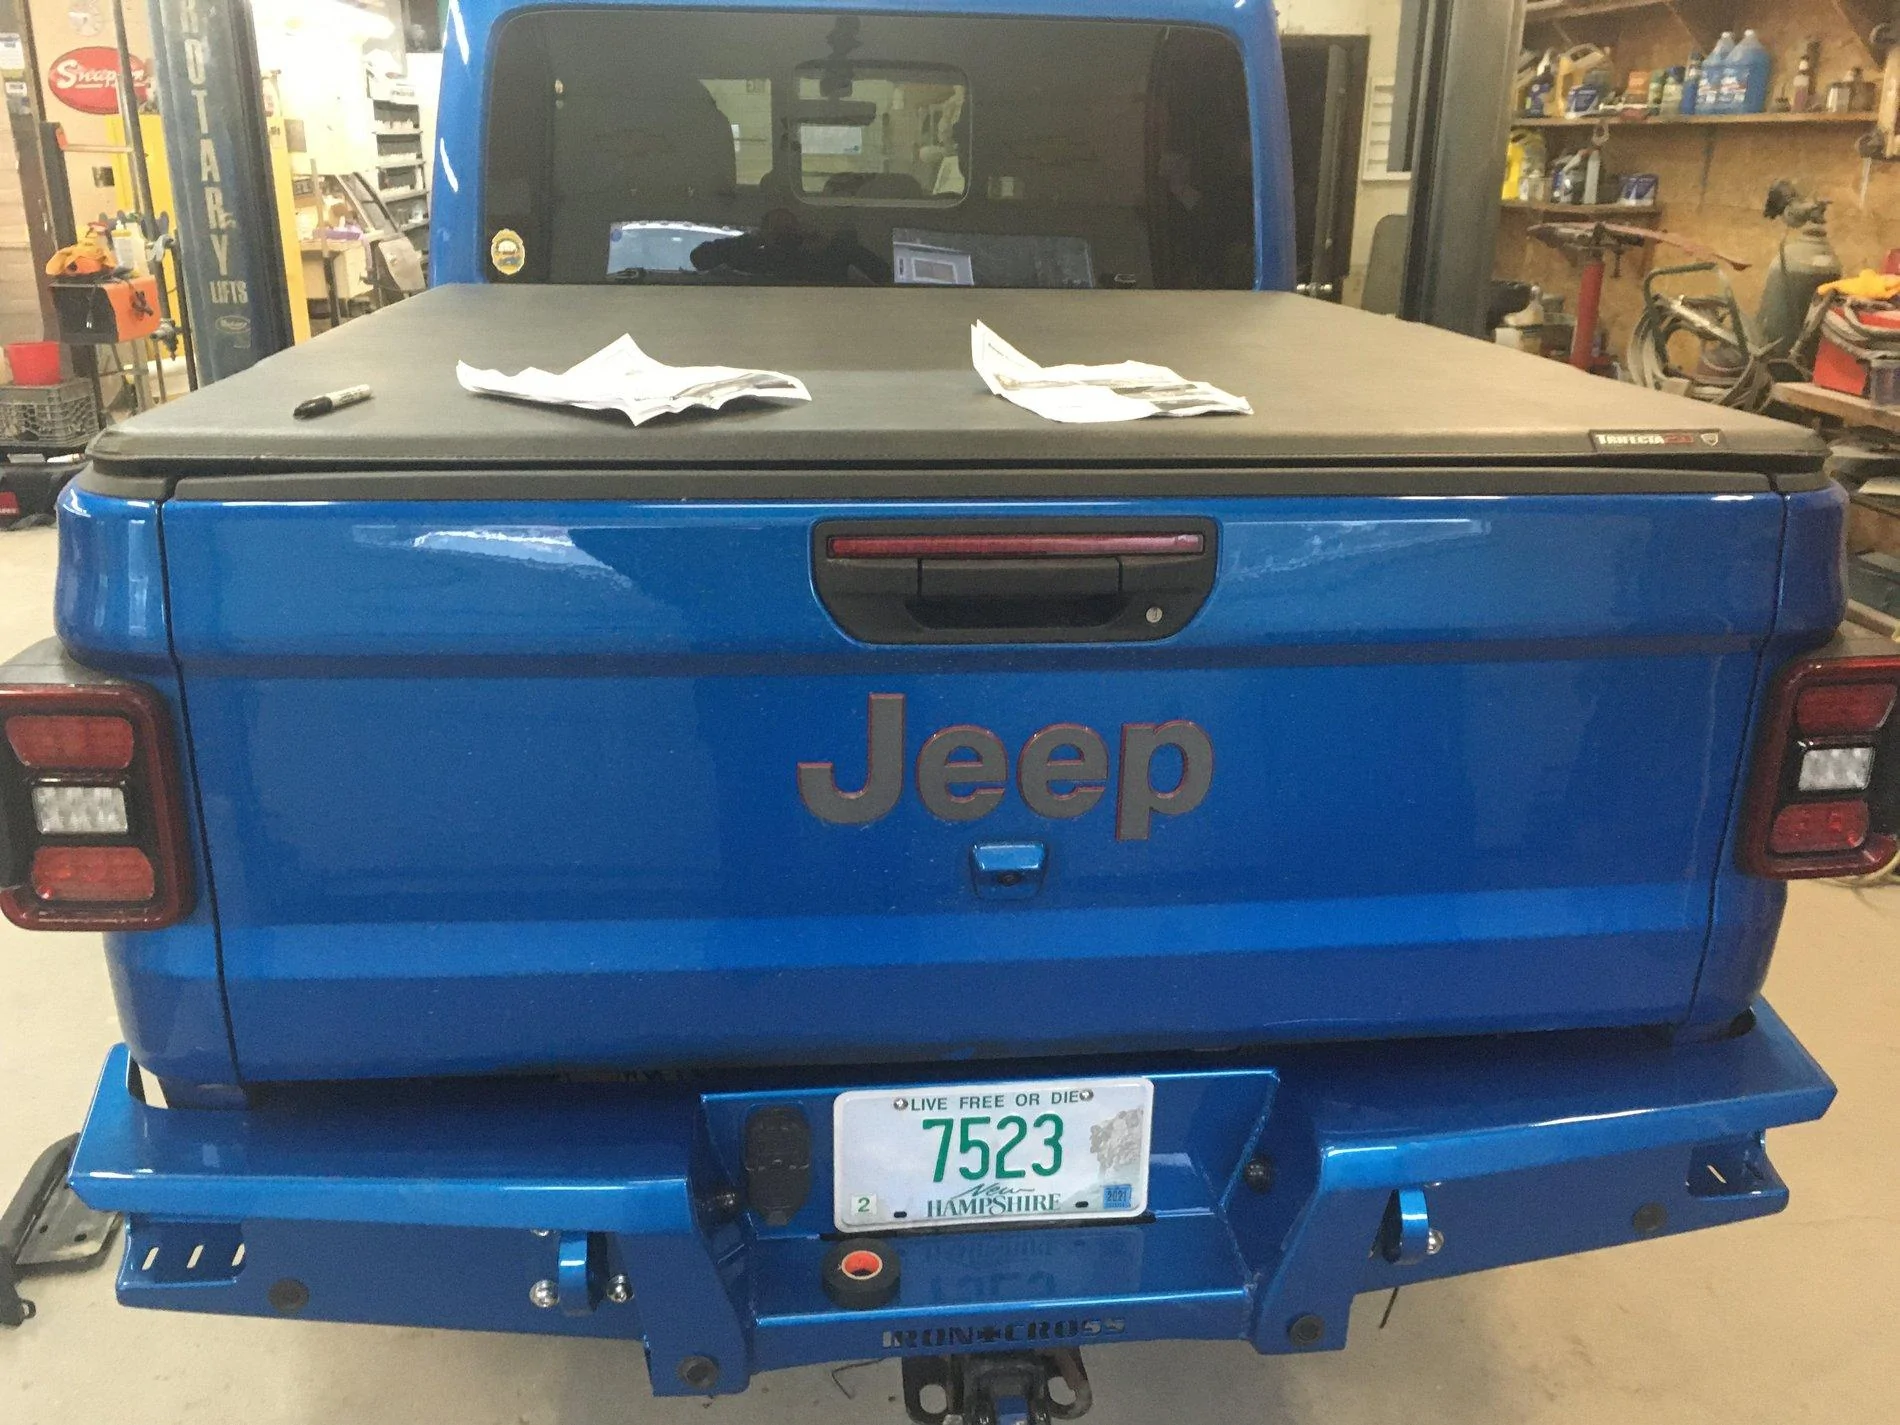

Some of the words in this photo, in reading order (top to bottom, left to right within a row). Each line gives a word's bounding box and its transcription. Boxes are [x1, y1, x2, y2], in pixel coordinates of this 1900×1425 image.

[210, 280, 249, 304] LIFTS
[797, 693, 1214, 841] Jeep
[910, 1097, 948, 1111] LIVE
[959, 1094, 1005, 1110] FREE
[1015, 1093, 1040, 1107] OR
[1051, 1090, 1080, 1105] DIE
[922, 1113, 1064, 1183] 7523
[857, 1197, 870, 1213] 2
[926, 1193, 1061, 1218] HAMPSHIRE
[882, 1326, 973, 1348] IRON
[1004, 1317, 1126, 1341] CROSS
